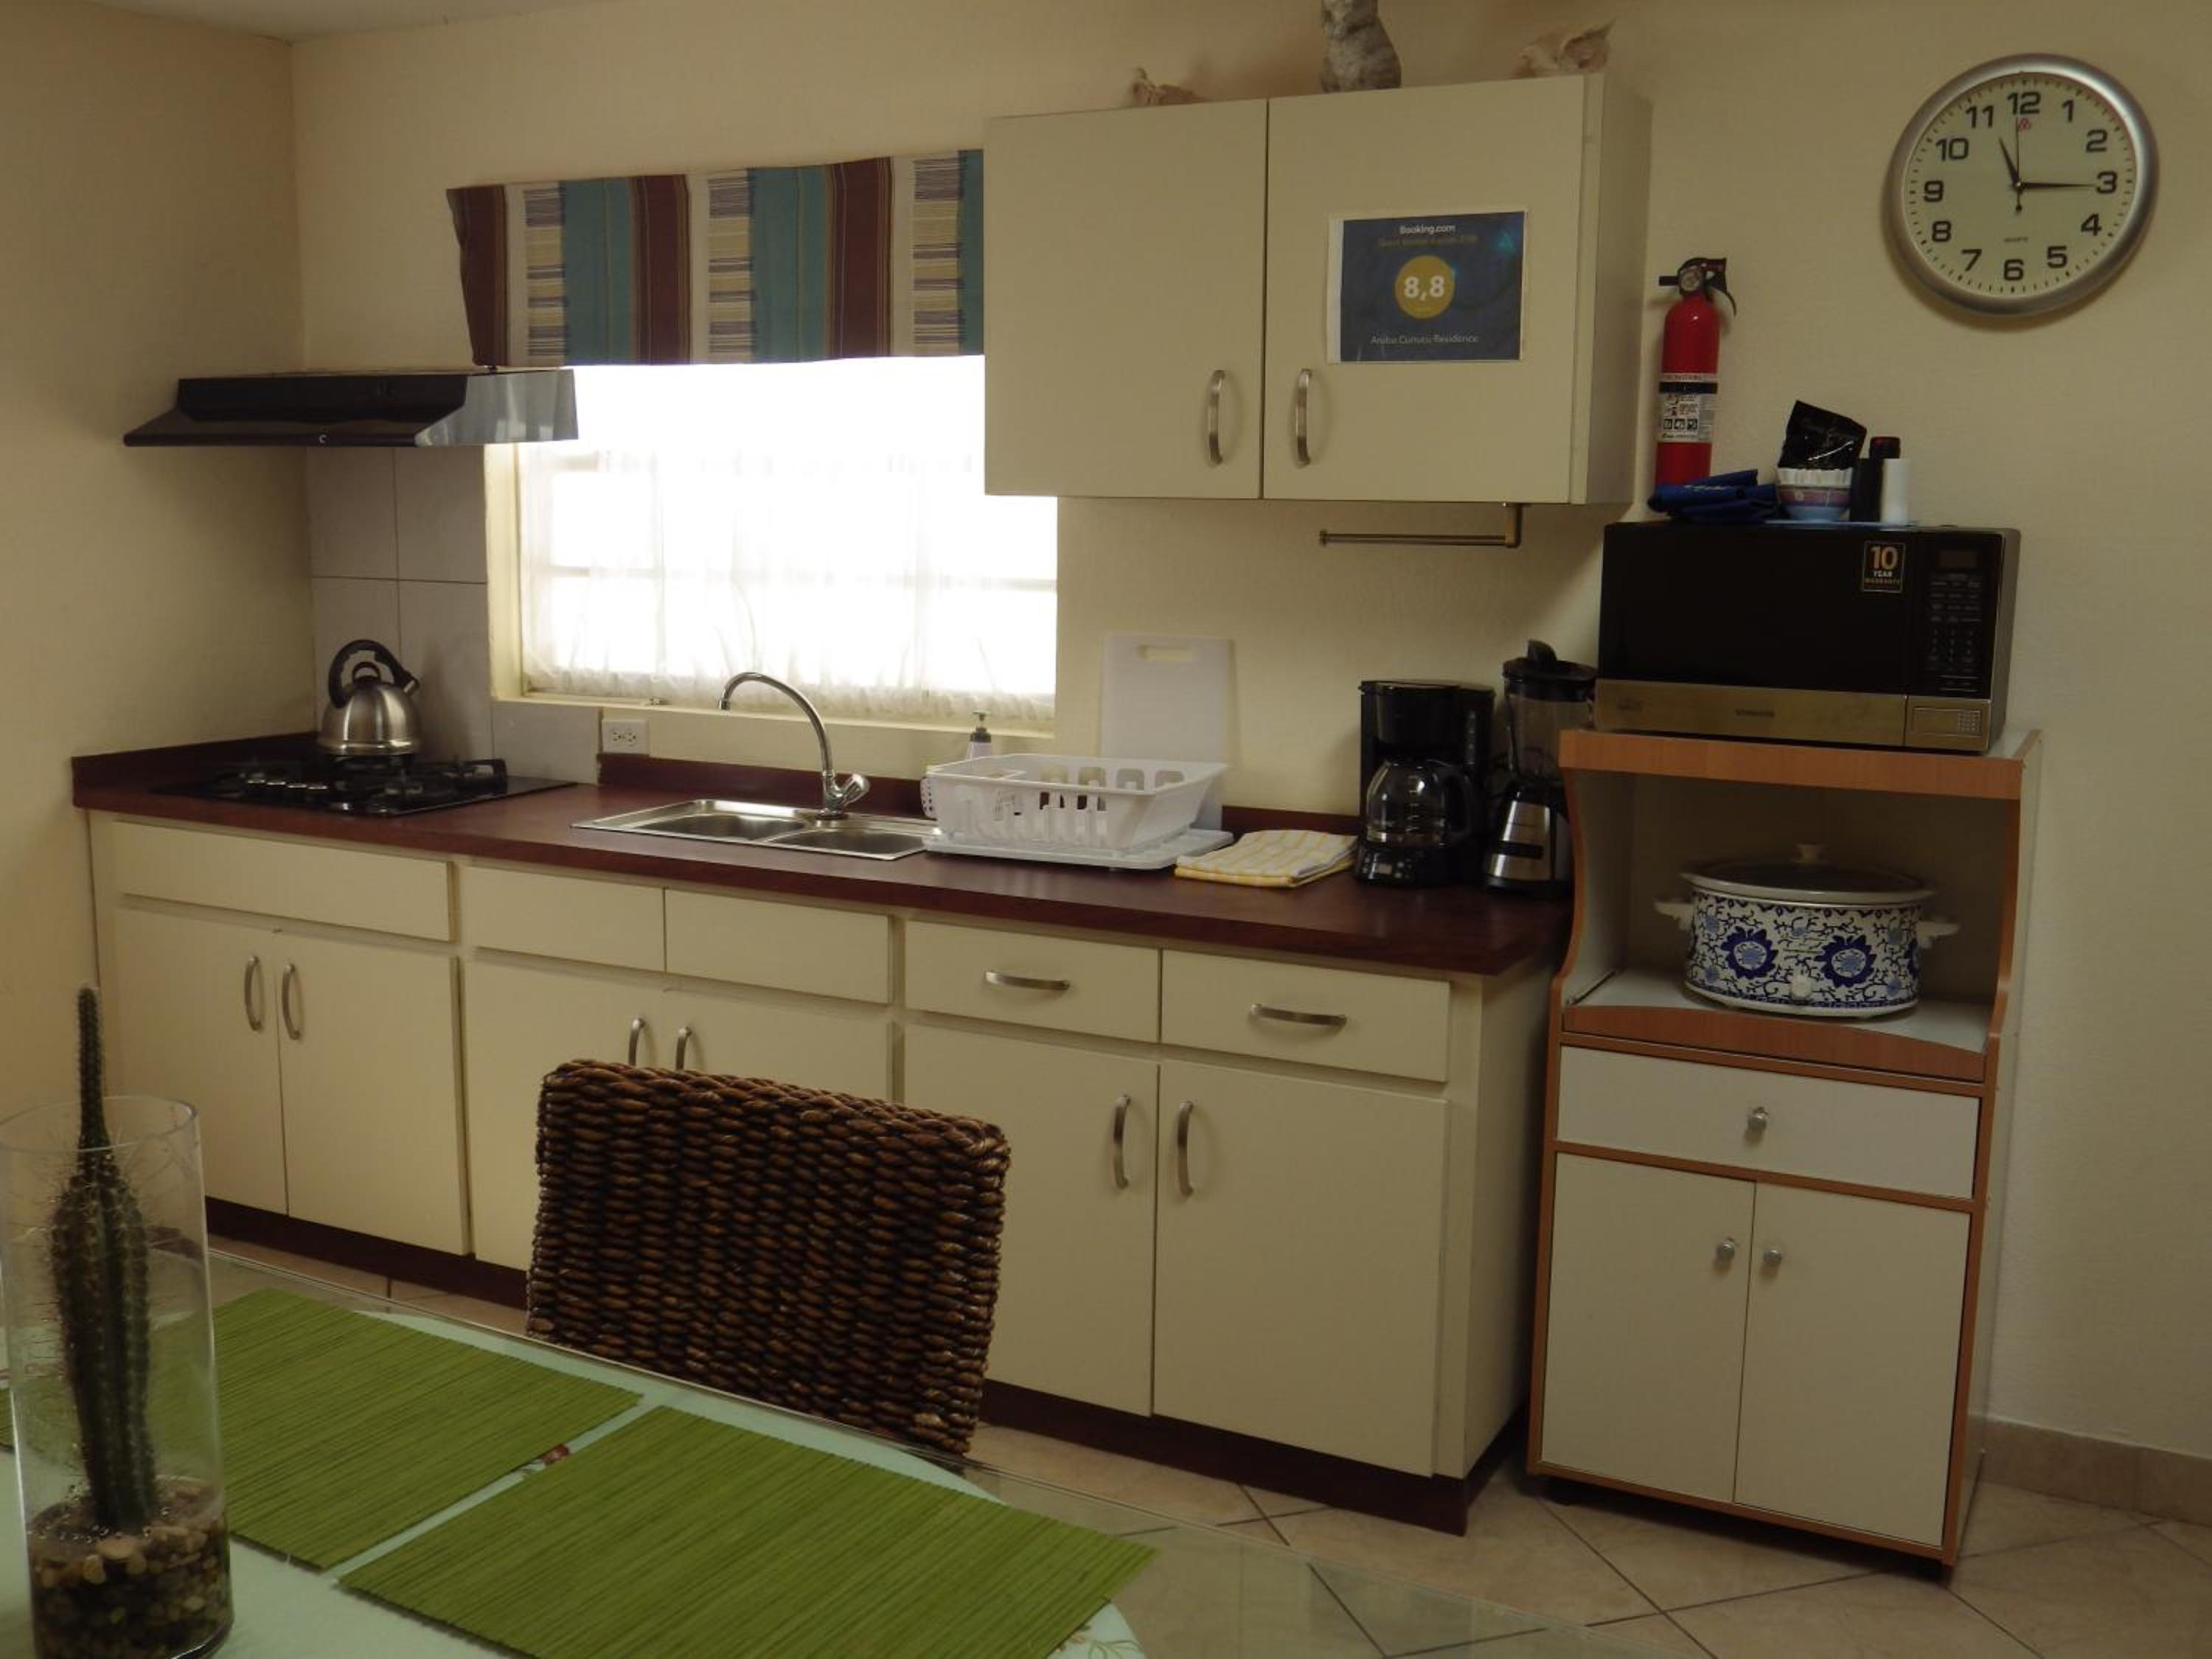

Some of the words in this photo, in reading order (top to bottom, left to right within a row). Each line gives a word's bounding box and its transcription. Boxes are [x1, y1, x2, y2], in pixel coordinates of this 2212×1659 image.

[2006, 91, 2041, 115] 12
[2062, 100, 2074, 122] 1
[1966, 105, 1994, 129] 11
[1935, 137, 1969, 161] 10
[2085, 128, 2108, 153] 2
[1923, 180, 1944, 203] 9
[2096, 170, 2118, 194] 3
[1399, 224, 1456, 235] Booking.com
[1931, 220, 1952, 243] 8
[2080, 213, 2102, 236] 4
[1961, 248, 1982, 272] 7
[2046, 246, 2067, 268] 5
[2003, 259, 2024, 281] 6
[1404, 275, 1445, 301] 8,8
[1870, 546, 1898, 570] 10
[1873, 570, 1893, 578] YEAR
